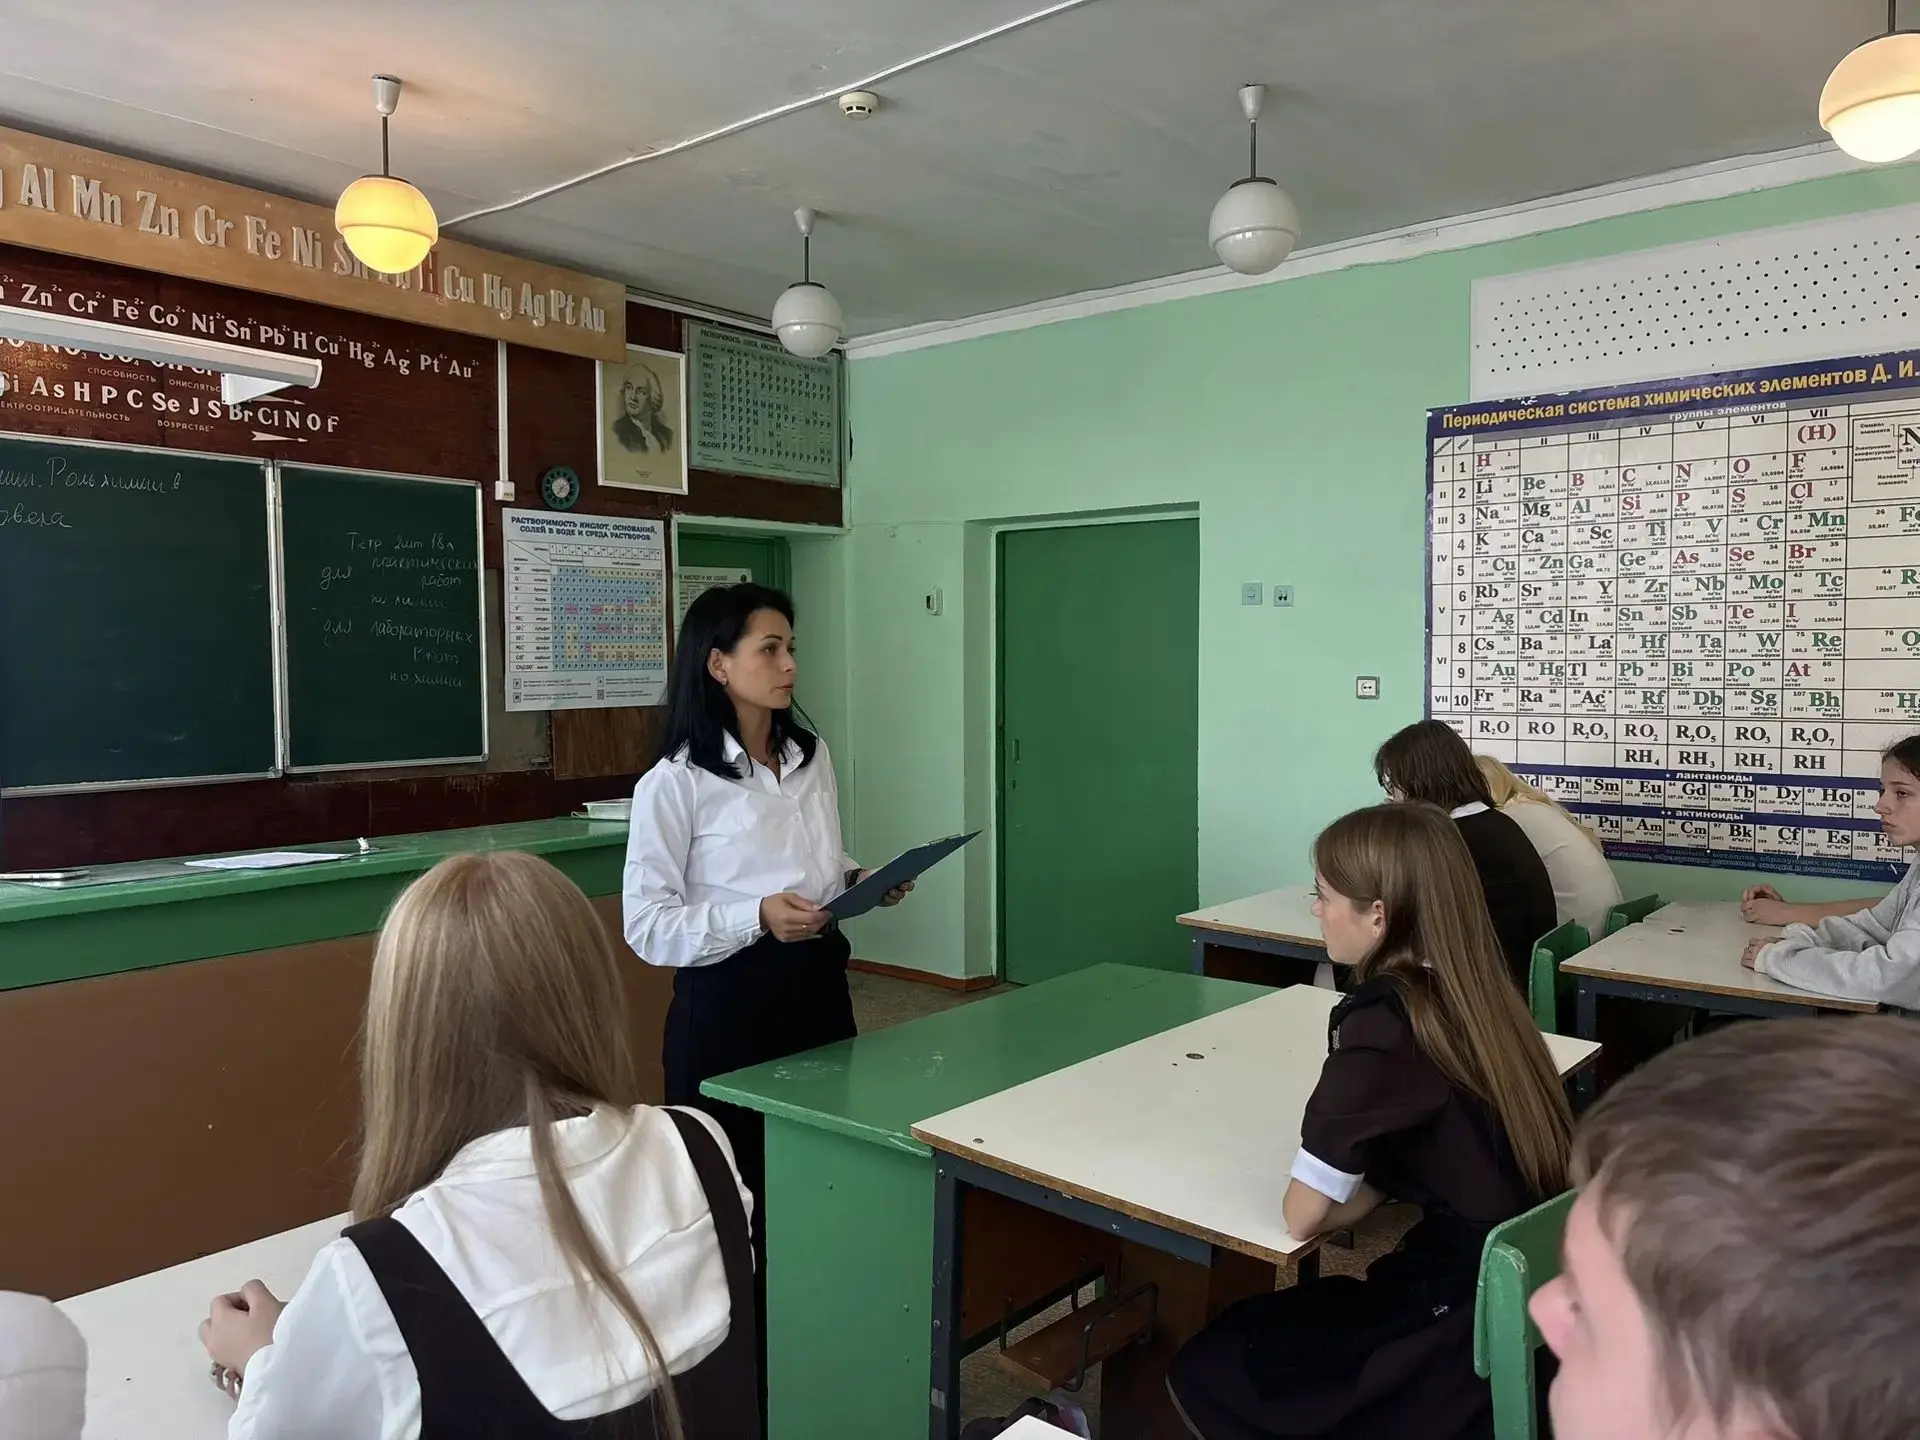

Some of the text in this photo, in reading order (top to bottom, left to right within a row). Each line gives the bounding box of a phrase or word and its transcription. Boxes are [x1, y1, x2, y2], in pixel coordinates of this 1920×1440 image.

[18, 163, 55, 212] Al
[71, 174, 123, 226] Mn
[136, 190, 180, 239] Zn
[194, 205, 234, 248] Cr
[245, 215, 281, 260] Fe
[292, 226, 323, 270] Ni
[444, 265, 476, 304] Cu
[483, 273, 512, 320] Hg
[519, 282, 546, 327] Ag
[550, 289, 576, 326] Pt
[579, 297, 606, 333] Au
[88, 367, 220, 394] СПОСОБНОСТЬ ОКИСЛЯТЬС
[30, 375, 65, 398] As
[73, 381, 91, 402] H
[101, 385, 118, 404] P
[127, 389, 143, 408] C
[152, 391, 180, 412] Se
[208, 400, 222, 418] S
[229, 404, 253, 422] Br
[285, 410, 300, 429] N
[327, 415, 340, 432] F
[1443, 405, 1564, 430] Периодическая
[1568, 395, 1641, 416] система
[1644, 381, 1755, 407] химических
[1760, 369, 1867, 393] элементов
[1871, 362, 1892, 384] Д.
[0, 401, 130, 422] ЕКТРООТРИЦАТЕЛЬНОСТЬ
[1669, 401, 1787, 421] группы элементов
[1797, 423, 1836, 443] (H)
[1477, 454, 1491, 467] H
[1733, 458, 1750, 474] O
[1792, 452, 1807, 468] F
[47, 456, 95, 488] Роль
[1622, 468, 1636, 483] C
[1676, 463, 1692, 478] N
[1476, 480, 1492, 494] Li
[1523, 477, 1546, 490] Be
[1572, 473, 1585, 487] B
[1732, 488, 1746, 503] S
[1790, 482, 1813, 499] Cl
[1572, 499, 1592, 514] Al
[1622, 495, 1641, 511] Si
[1675, 492, 1690, 506] P
[0, 502, 73, 529] овека
[1476, 506, 1499, 520] Na
[1522, 502, 1550, 517] Mg
[511, 516, 578, 528] РАСТВОРИМОСТЬ
[520, 524, 547, 534] СОЛЕЙ
[556, 527, 575, 536] ВОДЕ
[585, 530, 608, 538] СРЕДА
[610, 532, 651, 541] РАСТВОРОВ
[1674, 550, 1699, 565] As
[1729, 547, 1755, 562] Se
[1788, 544, 1817, 559] Br
[1492, 557, 1516, 571] Cu
[1539, 556, 1564, 569] Zn
[1569, 554, 1594, 569] Ga
[1620, 552, 1646, 567] Ge
[1492, 610, 1514, 625] Ag
[1539, 609, 1564, 624] Cd
[1569, 609, 1589, 622] In
[1618, 608, 1644, 622] Sn
[1671, 605, 1698, 621] Sb
[1727, 604, 1755, 619] Te
[1474, 637, 1495, 650] Cs
[1520, 637, 1543, 650] Ba
[1640, 634, 1667, 649] Hf
[1695, 633, 1722, 648] Ta
[1756, 632, 1782, 648] W
[1811, 632, 1842, 647] Re
[1491, 663, 1516, 676] Au
[1539, 662, 1564, 677] Hg
[1568, 663, 1587, 676] Tl
[1618, 662, 1644, 676] Pb
[1672, 662, 1694, 677] Bi
[1727, 662, 1755, 677] Po
[1785, 662, 1811, 677] At
[1454, 694, 1469, 707] 10
[1528, 722, 1555, 734] RO
[1793, 754, 1826, 770] RH
[1675, 771, 1753, 783] лантаноиды
[1681, 782, 1707, 797] Gd
[1729, 784, 1755, 799] Tb
[1776, 786, 1802, 802] Dy
[1821, 788, 1851, 803] Ho
[1675, 809, 1744, 821] актиноиды
[1680, 820, 1707, 835] Cm
[1729, 823, 1753, 838] Bk
[1777, 826, 1801, 842] Cf
[1827, 829, 1851, 845] Es
